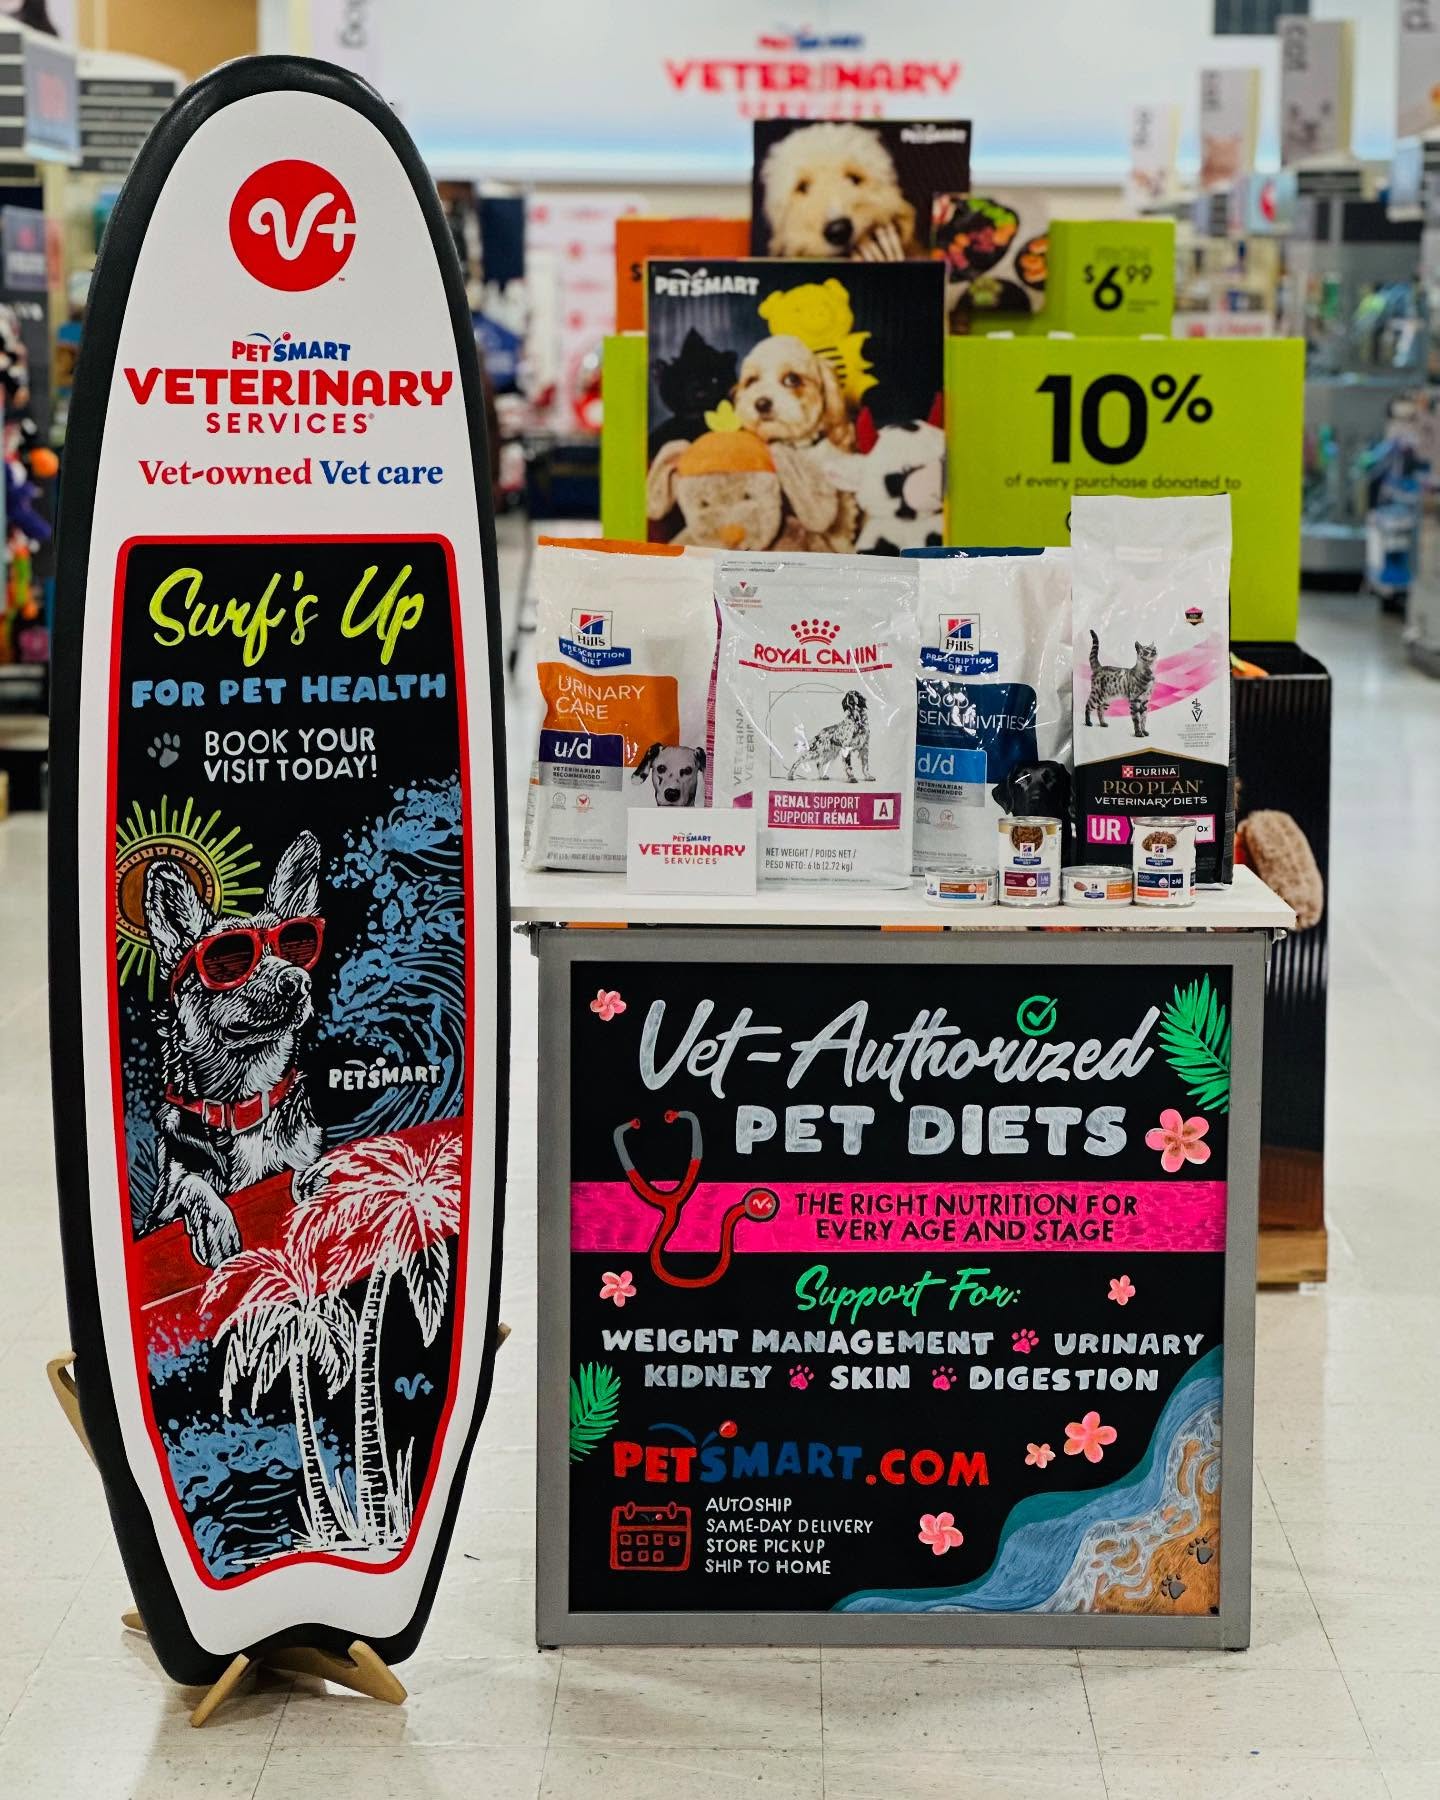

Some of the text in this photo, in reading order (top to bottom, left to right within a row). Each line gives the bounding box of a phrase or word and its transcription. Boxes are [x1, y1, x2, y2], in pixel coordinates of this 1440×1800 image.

[663, 59, 960, 92] VETERINARY
[654, 274, 760, 296] PETSMART
[232, 338, 351, 363] PETSMART
[124, 368, 453, 407] VETERINARY
[1035, 373, 1213, 465] 10%
[139, 458, 444, 486] Vet-owned Vet care
[1005, 473, 1241, 490] of every purchase donated to
[149, 565, 424, 667] Surf's Up
[577, 635, 606, 646] Hill's
[945, 639, 974, 651] Hill's
[582, 656, 602, 665] DIET
[754, 643, 877, 665] ROYAL CANIN
[131, 674, 447, 708] FOR PET HEALTH
[558, 675, 645, 701] URINARY
[556, 696, 608, 720] CARE
[204, 727, 376, 756] BOOK YOUR
[554, 738, 592, 759] u/d
[203, 755, 378, 783] VISIT TODAY!
[553, 766, 601, 774] VETERINARIAN
[918, 752, 955, 775] d/d
[1135, 768, 1177, 776] PURINA
[1103, 780, 1200, 795] PRO PLAN
[774, 794, 861, 809] RENAL SUPPORT
[878, 801, 888, 817] A
[1094, 796, 1208, 808] VETERINARY DIETS
[773, 807, 860, 825] SUPPORT RÉNAL
[672, 834, 711, 842] PETSMART
[1091, 818, 1121, 841] UR
[639, 843, 746, 856] VETERINARY
[765, 848, 779, 857] NET
[781, 848, 808, 858] WEIGHT
[815, 849, 836, 858] POIDS
[838, 849, 852, 858] NET
[664, 857, 718, 865] SERVICES
[765, 860, 783, 869] PESO
[329, 1062, 441, 1091] PETSMART
[735, 1104, 1128, 1156] PET DIETS
[795, 1192, 1138, 1218] THE RIGHT NUTRITION FOR
[816, 1218, 1114, 1242] EVERY AGE AND STAGE
[795, 1264, 1021, 1326] Support For:
[601, 1328, 1205, 1356] WEIGHT MANAGEMENT URINARY
[644, 1364, 1159, 1391] KIDNEY SKIN DIGESTION
[705, 1497, 793, 1513] AUTOSHIP
[706, 1518, 875, 1535] SAME-DAY DELIVERY
[706, 1539, 826, 1554] STORE PICKUP
[704, 1559, 832, 1576] SHIP TO HOME
